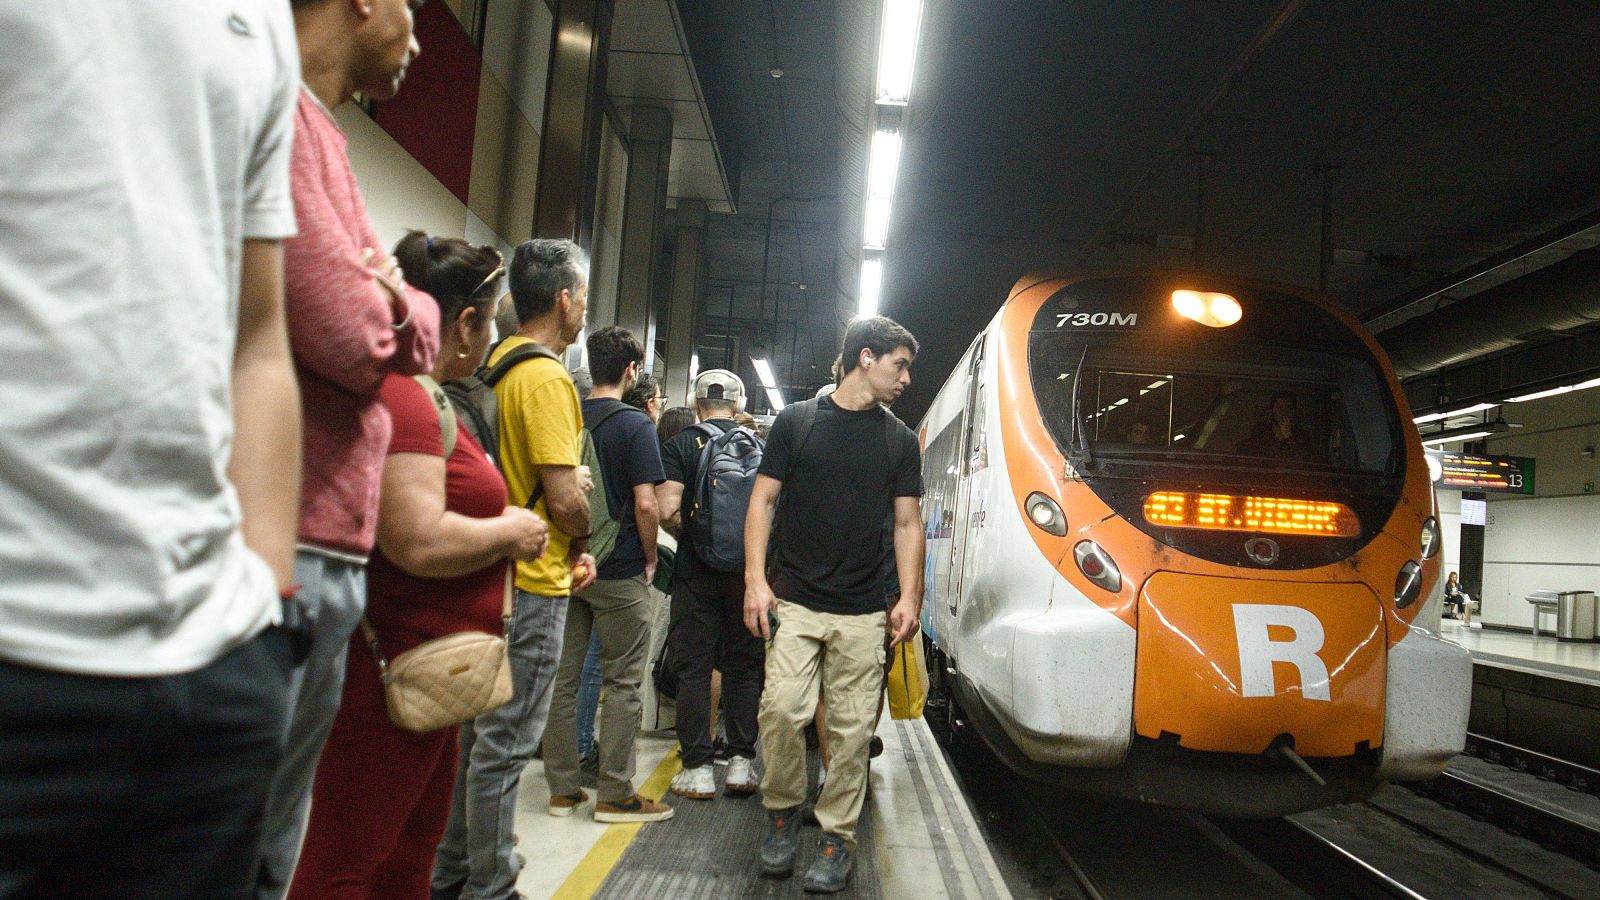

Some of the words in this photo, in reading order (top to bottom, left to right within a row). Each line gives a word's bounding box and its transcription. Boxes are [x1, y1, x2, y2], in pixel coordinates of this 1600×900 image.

[1056, 312, 1138, 328] 730M
[1509, 474, 1523, 488] 13
[1232, 603, 1331, 702] R
